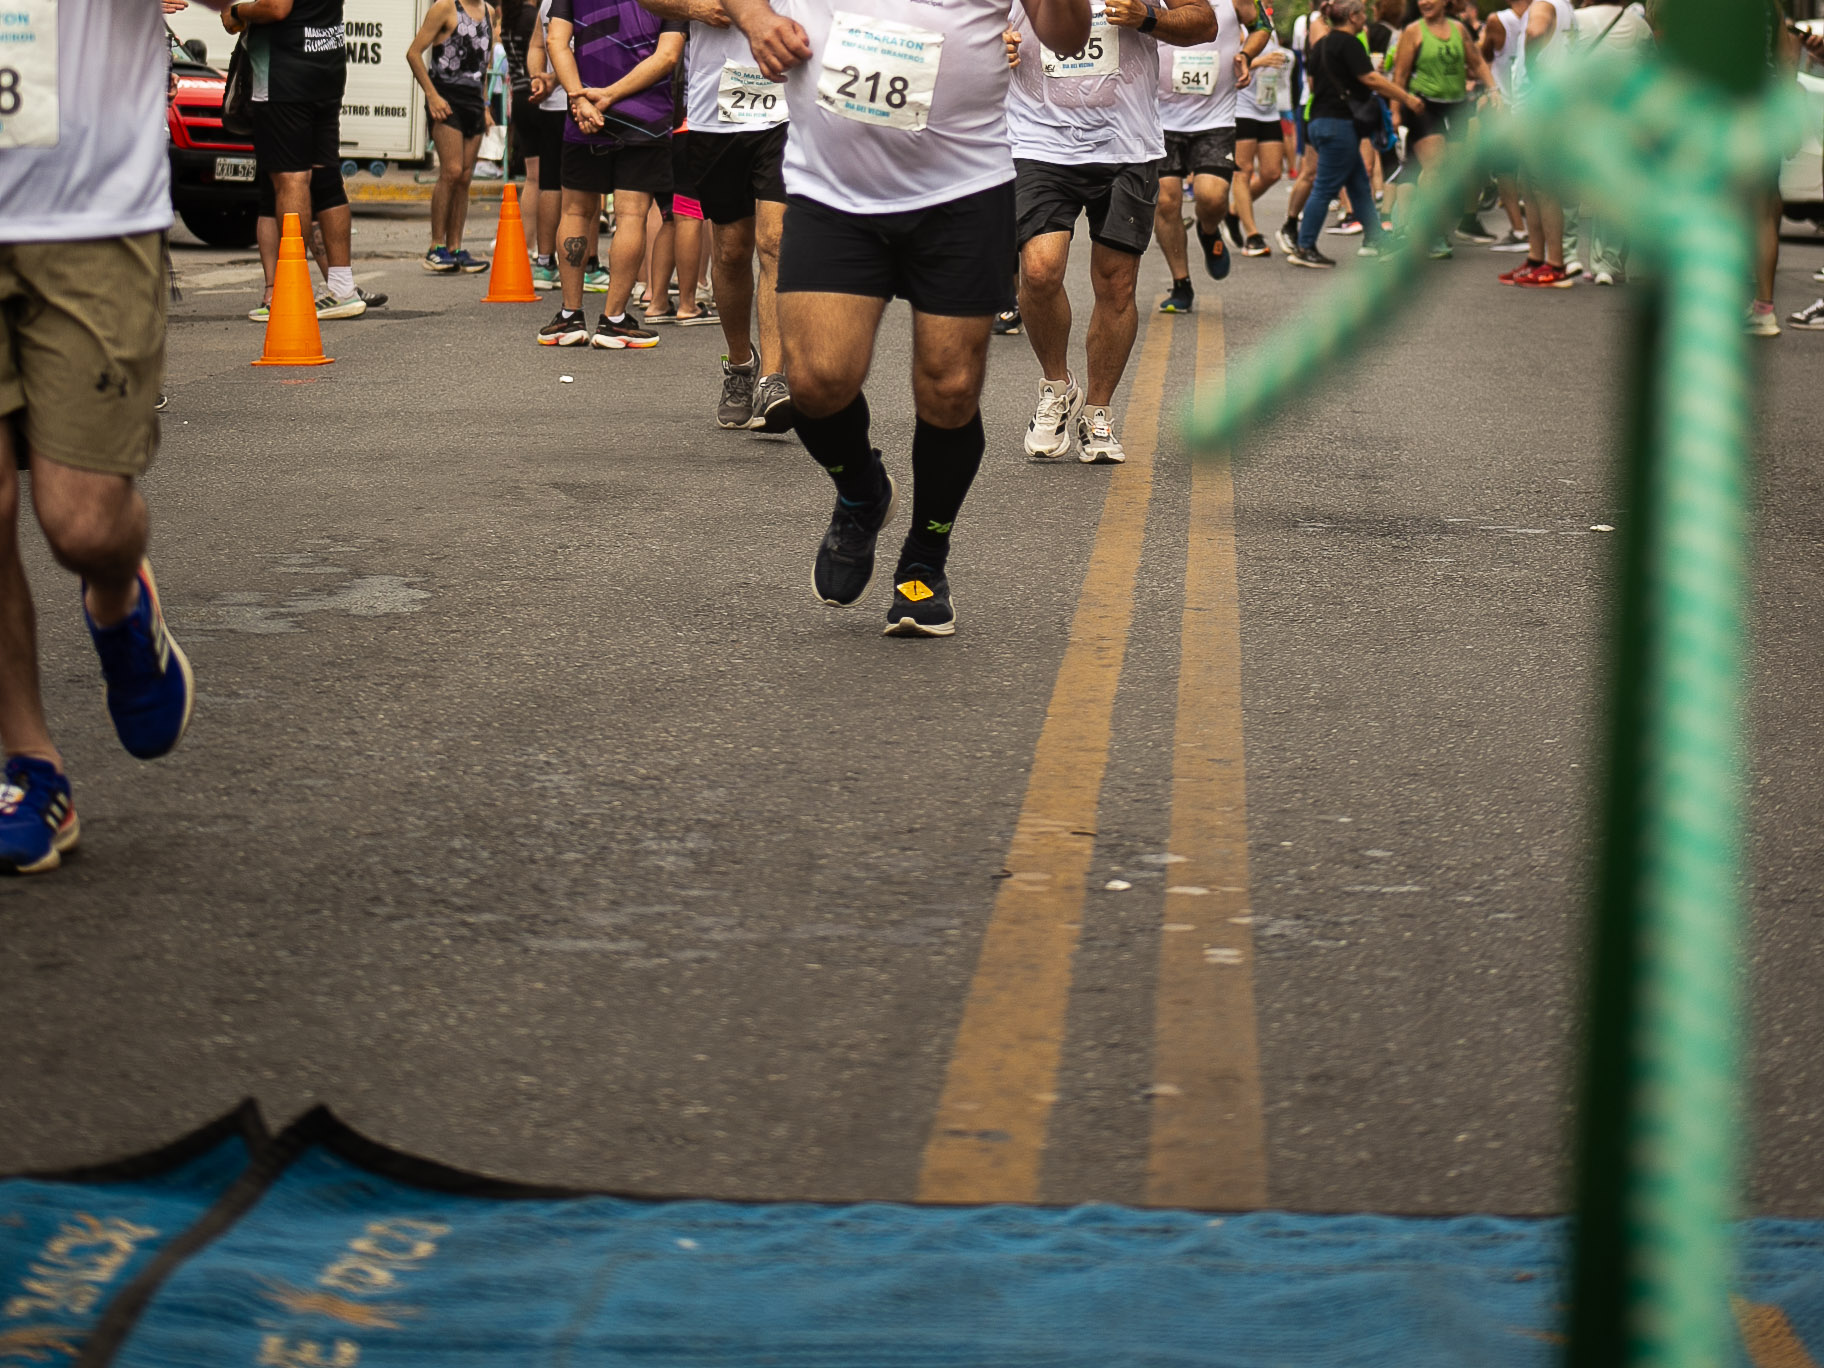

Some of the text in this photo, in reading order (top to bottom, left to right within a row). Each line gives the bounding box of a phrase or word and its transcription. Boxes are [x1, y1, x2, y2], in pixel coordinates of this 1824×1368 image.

[345, 21, 383, 39] OMOS
[346, 42, 382, 65] NAS
[837, 65, 909, 109] 218
[1181, 71, 1209, 85] 541
[731, 90, 777, 110] 270
[341, 104, 371, 117] STROS
